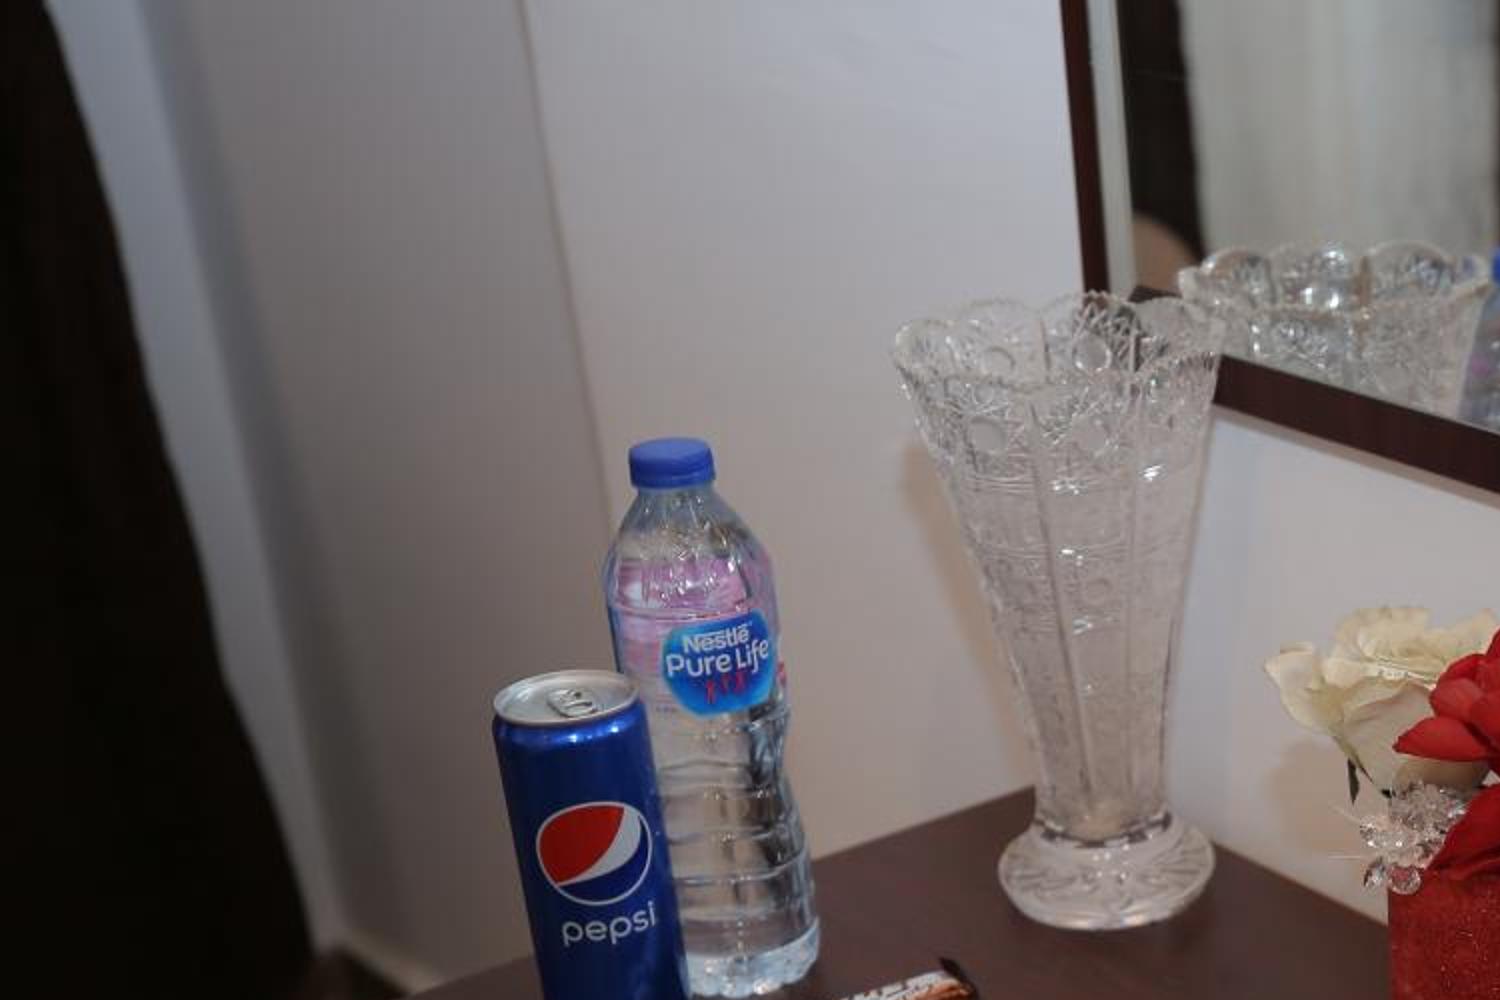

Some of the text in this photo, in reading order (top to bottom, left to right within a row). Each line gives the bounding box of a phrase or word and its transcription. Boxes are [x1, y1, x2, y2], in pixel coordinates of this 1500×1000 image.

[665, 639, 770, 678] Pure Life
[561, 899, 657, 948] pepsi
